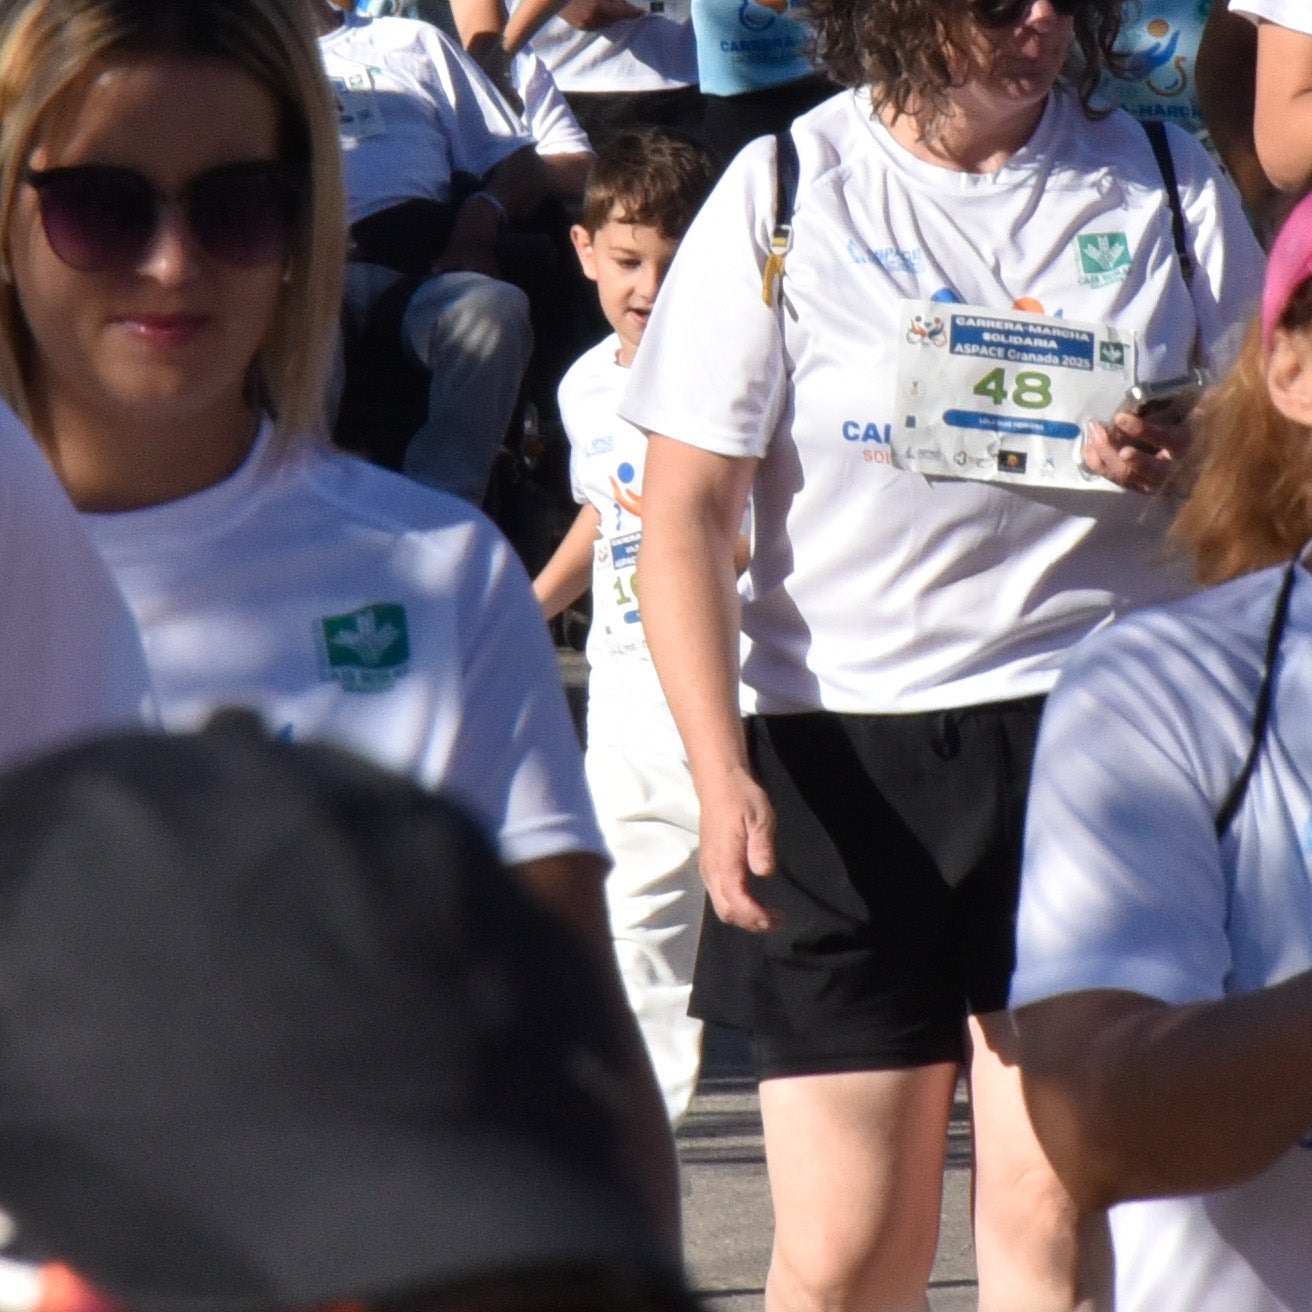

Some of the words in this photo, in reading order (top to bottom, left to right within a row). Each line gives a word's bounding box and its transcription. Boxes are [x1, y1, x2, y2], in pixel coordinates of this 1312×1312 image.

[954, 315, 1091, 343] CARRERA-MARCHA
[981, 331, 1059, 351] SOLIDARIA
[953, 342, 1005, 358] ASPACE
[1006, 348, 1060, 366] Granada
[972, 365, 1053, 410] 48
